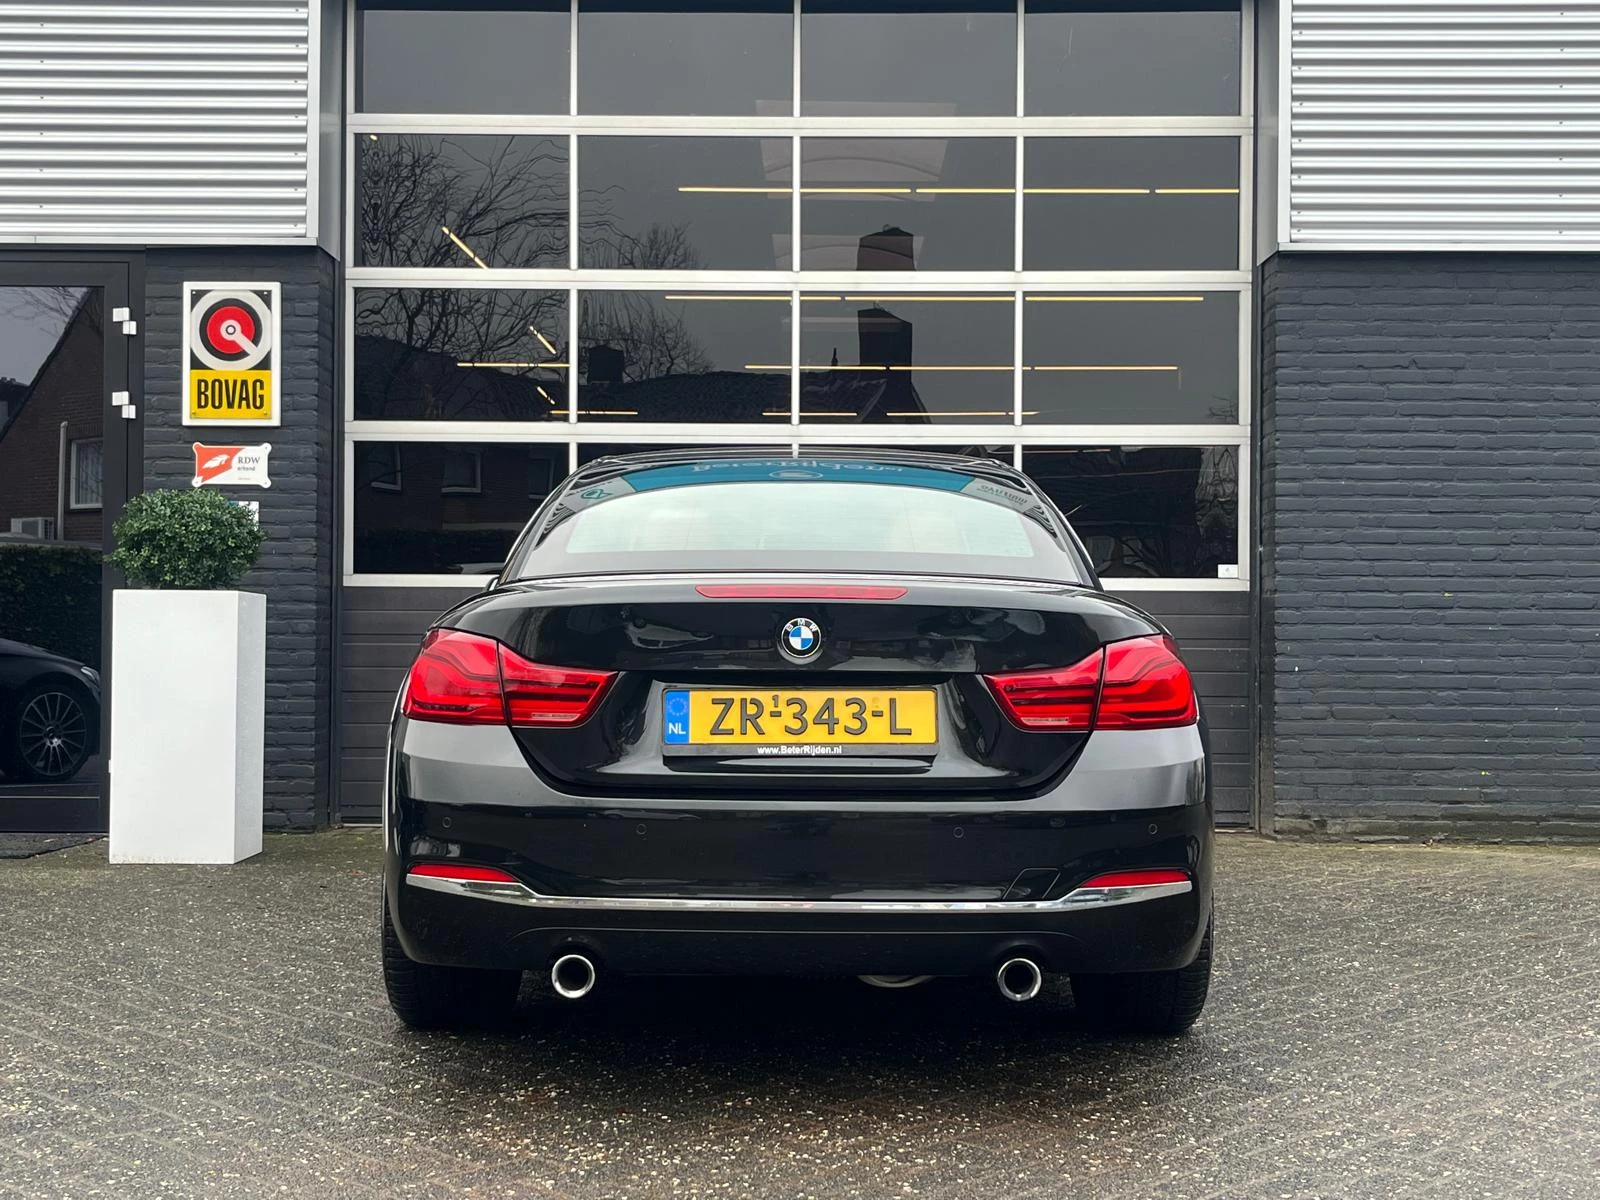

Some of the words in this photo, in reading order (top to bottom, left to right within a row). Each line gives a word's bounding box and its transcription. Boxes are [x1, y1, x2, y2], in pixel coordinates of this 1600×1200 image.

[197, 379, 265, 410] BOVAG
[238, 456, 260, 464] RDW
[784, 618, 819, 632] BMW
[668, 722, 687, 735] NL
[757, 745, 843, 756] www.BeterRijden.nl
